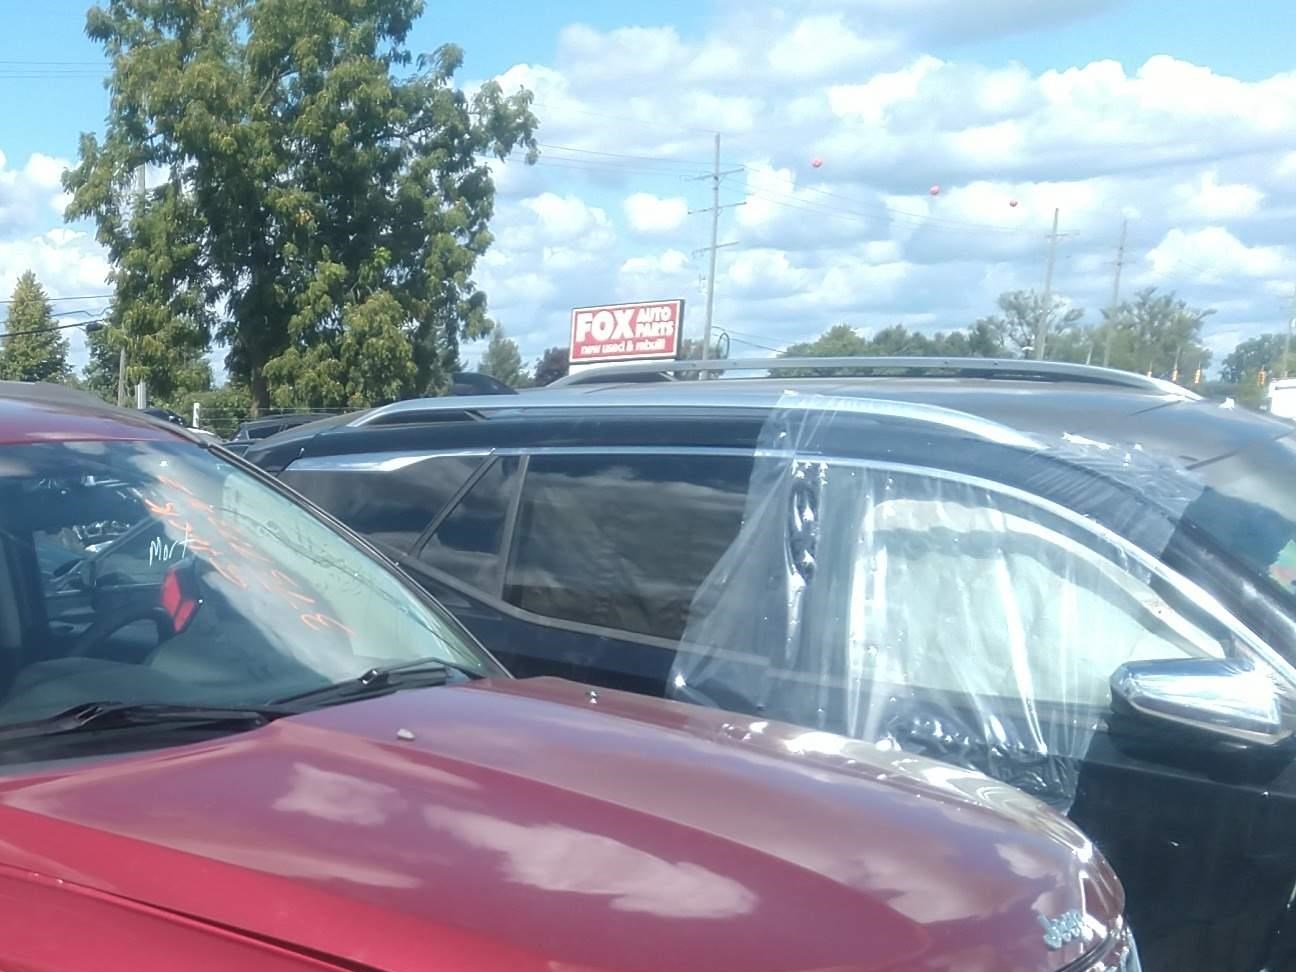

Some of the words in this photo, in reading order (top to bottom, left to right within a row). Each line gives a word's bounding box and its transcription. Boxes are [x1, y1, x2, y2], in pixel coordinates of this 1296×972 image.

[636, 306, 672, 323] AUTO
[575, 309, 634, 342] FOX
[635, 321, 675, 338] PARTS
